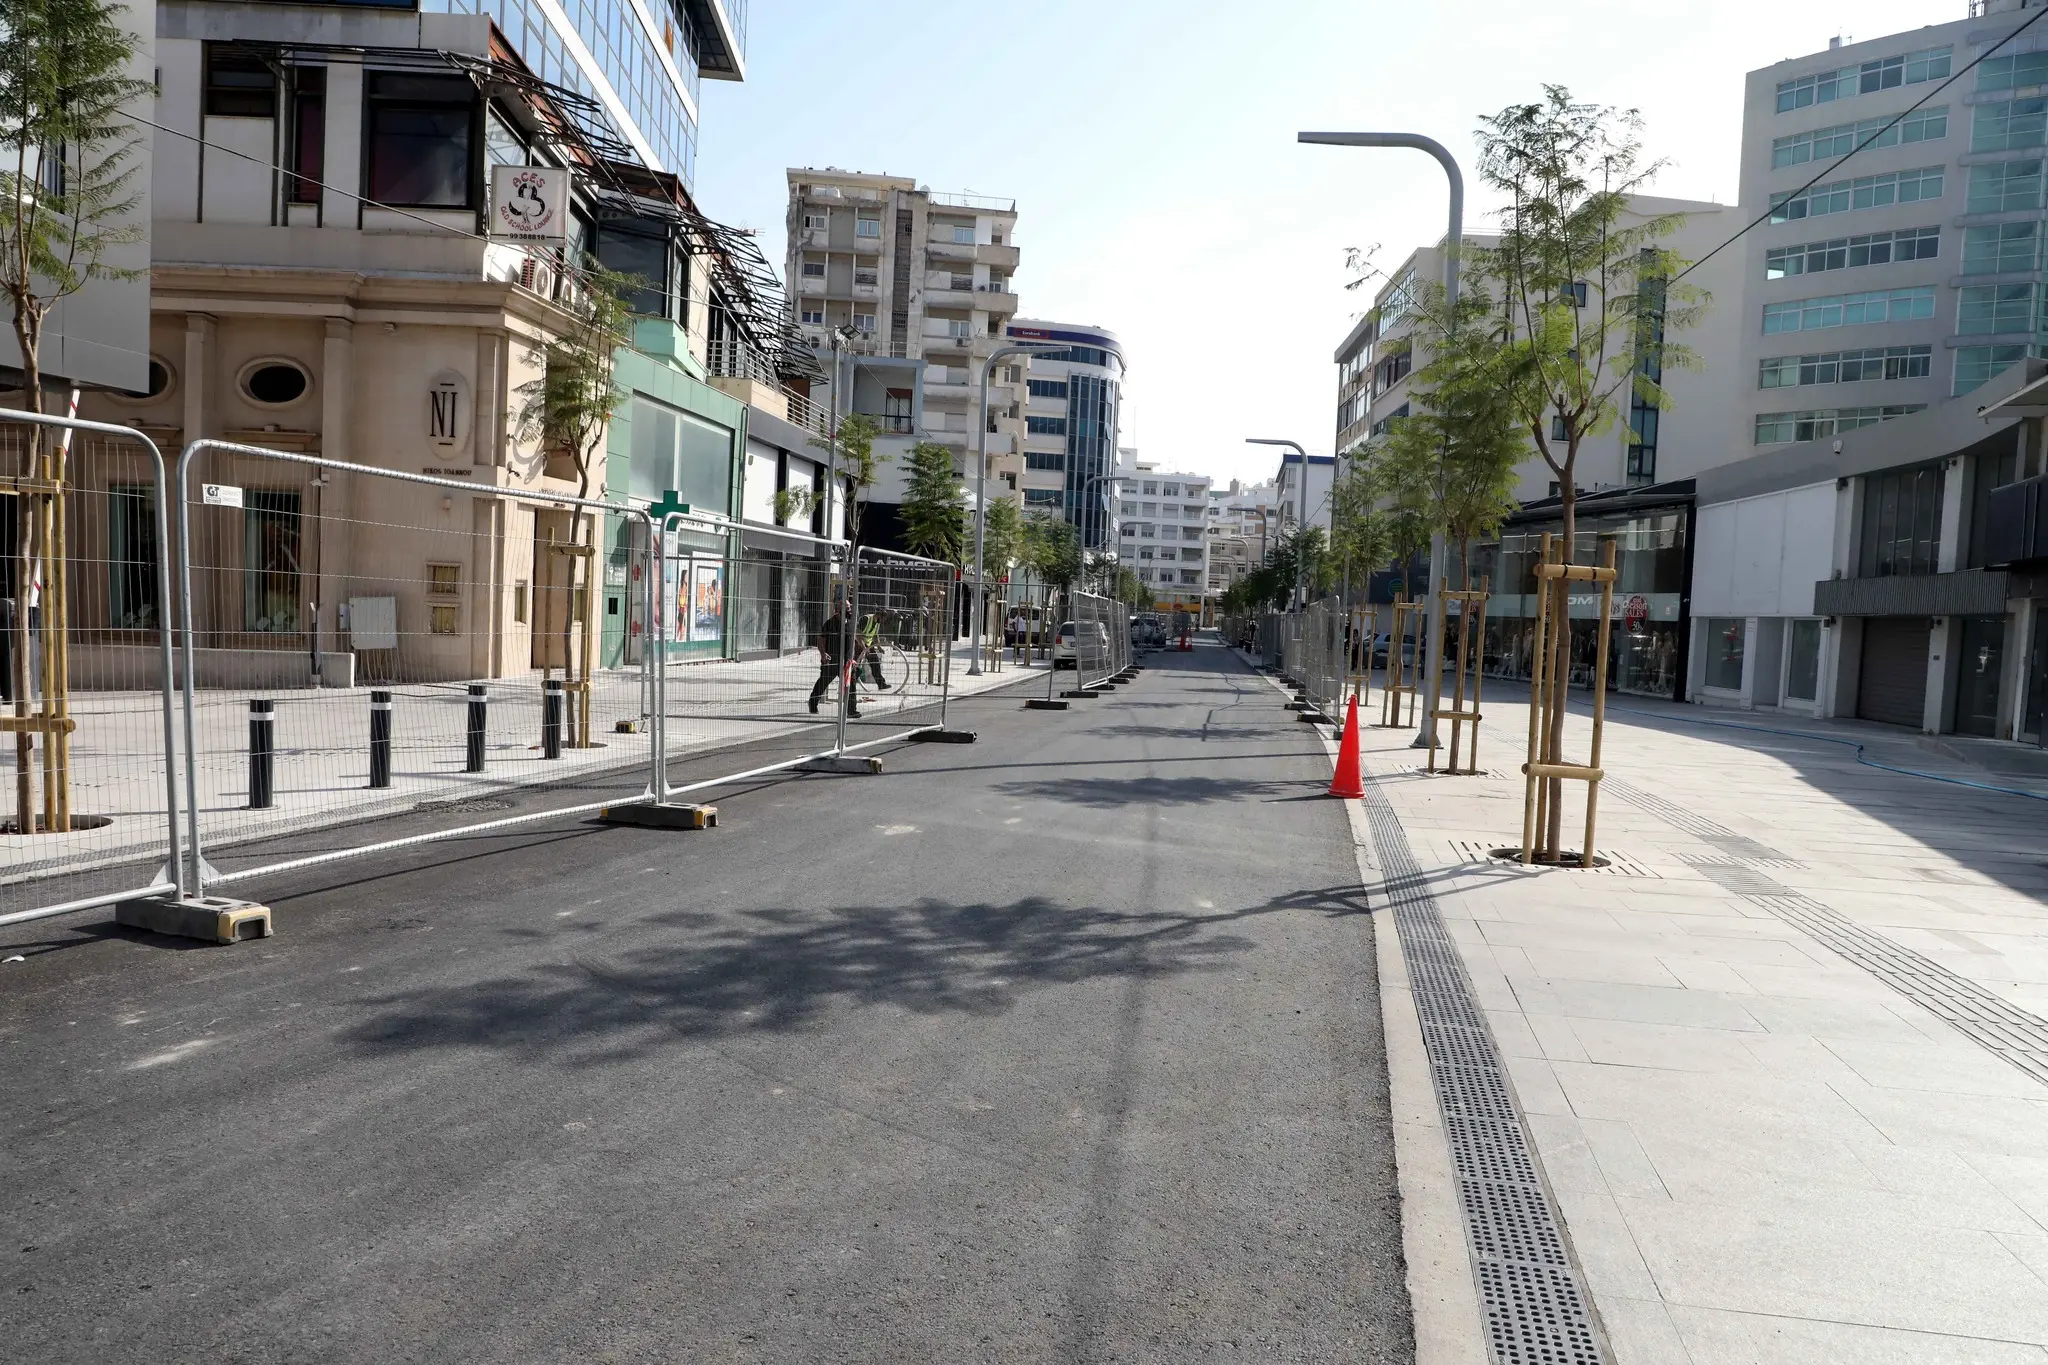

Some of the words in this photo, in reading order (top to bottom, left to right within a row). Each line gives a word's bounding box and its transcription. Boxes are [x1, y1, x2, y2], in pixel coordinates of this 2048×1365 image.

[512, 172, 545, 188] ACES
[501, 206, 510, 220] OLD
[508, 219, 533, 231] SCHOOL
[430, 391, 457, 437] NI
[207, 486, 219, 496] GT
